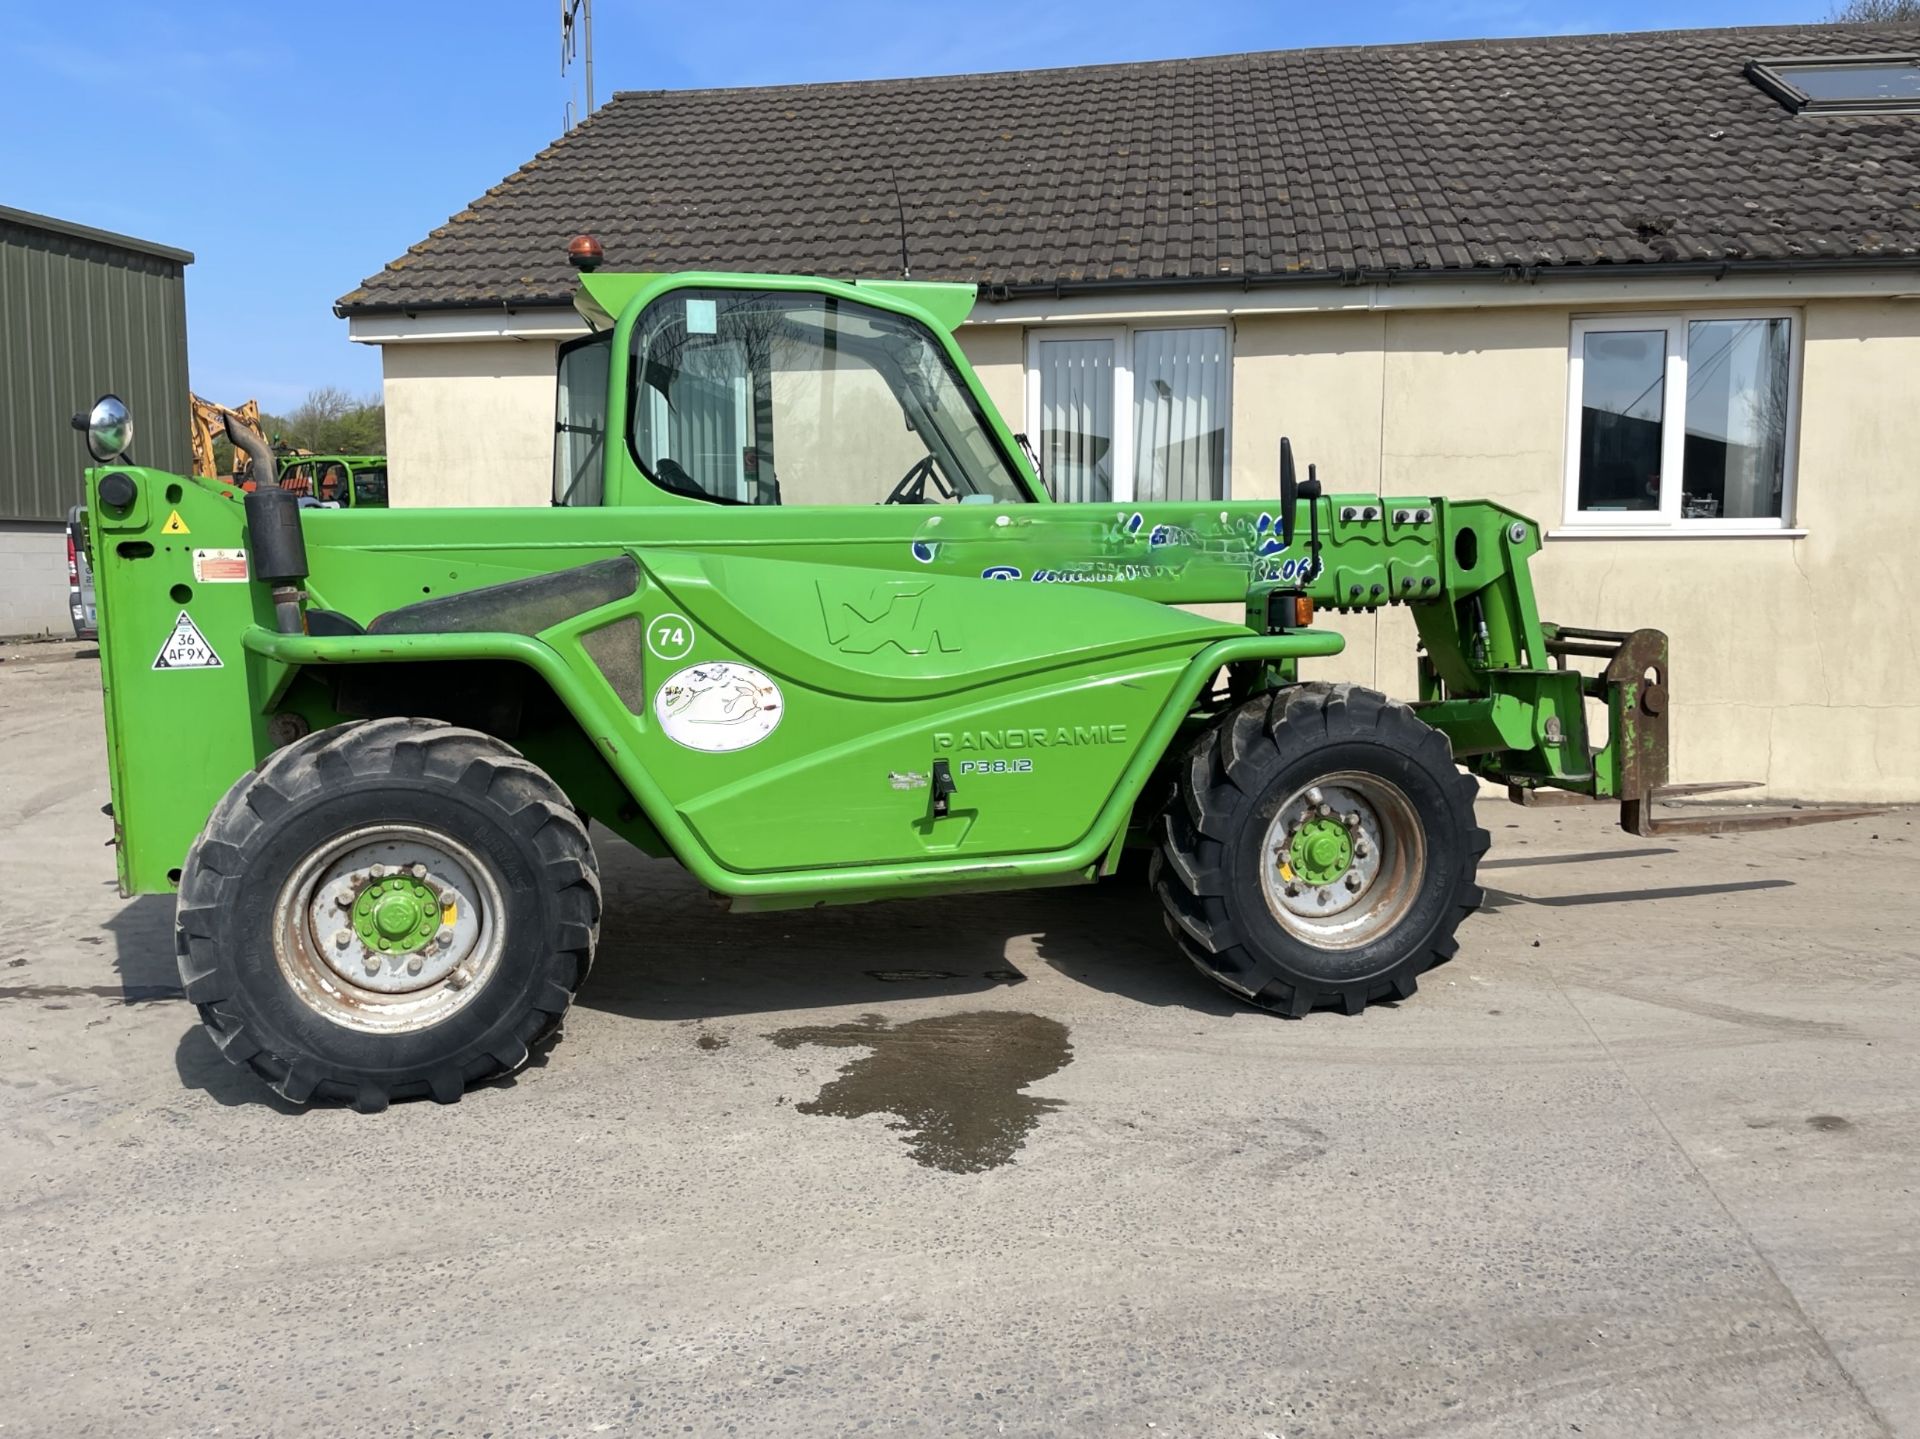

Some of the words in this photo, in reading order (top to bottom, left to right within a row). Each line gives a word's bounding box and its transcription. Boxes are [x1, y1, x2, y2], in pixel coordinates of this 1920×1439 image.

[178, 634, 195, 646] 36
[658, 628, 685, 646] 74
[169, 648, 205, 661] AF9X
[933, 724, 1127, 752] PANORAMIC
[960, 759, 1033, 774] P38.12
